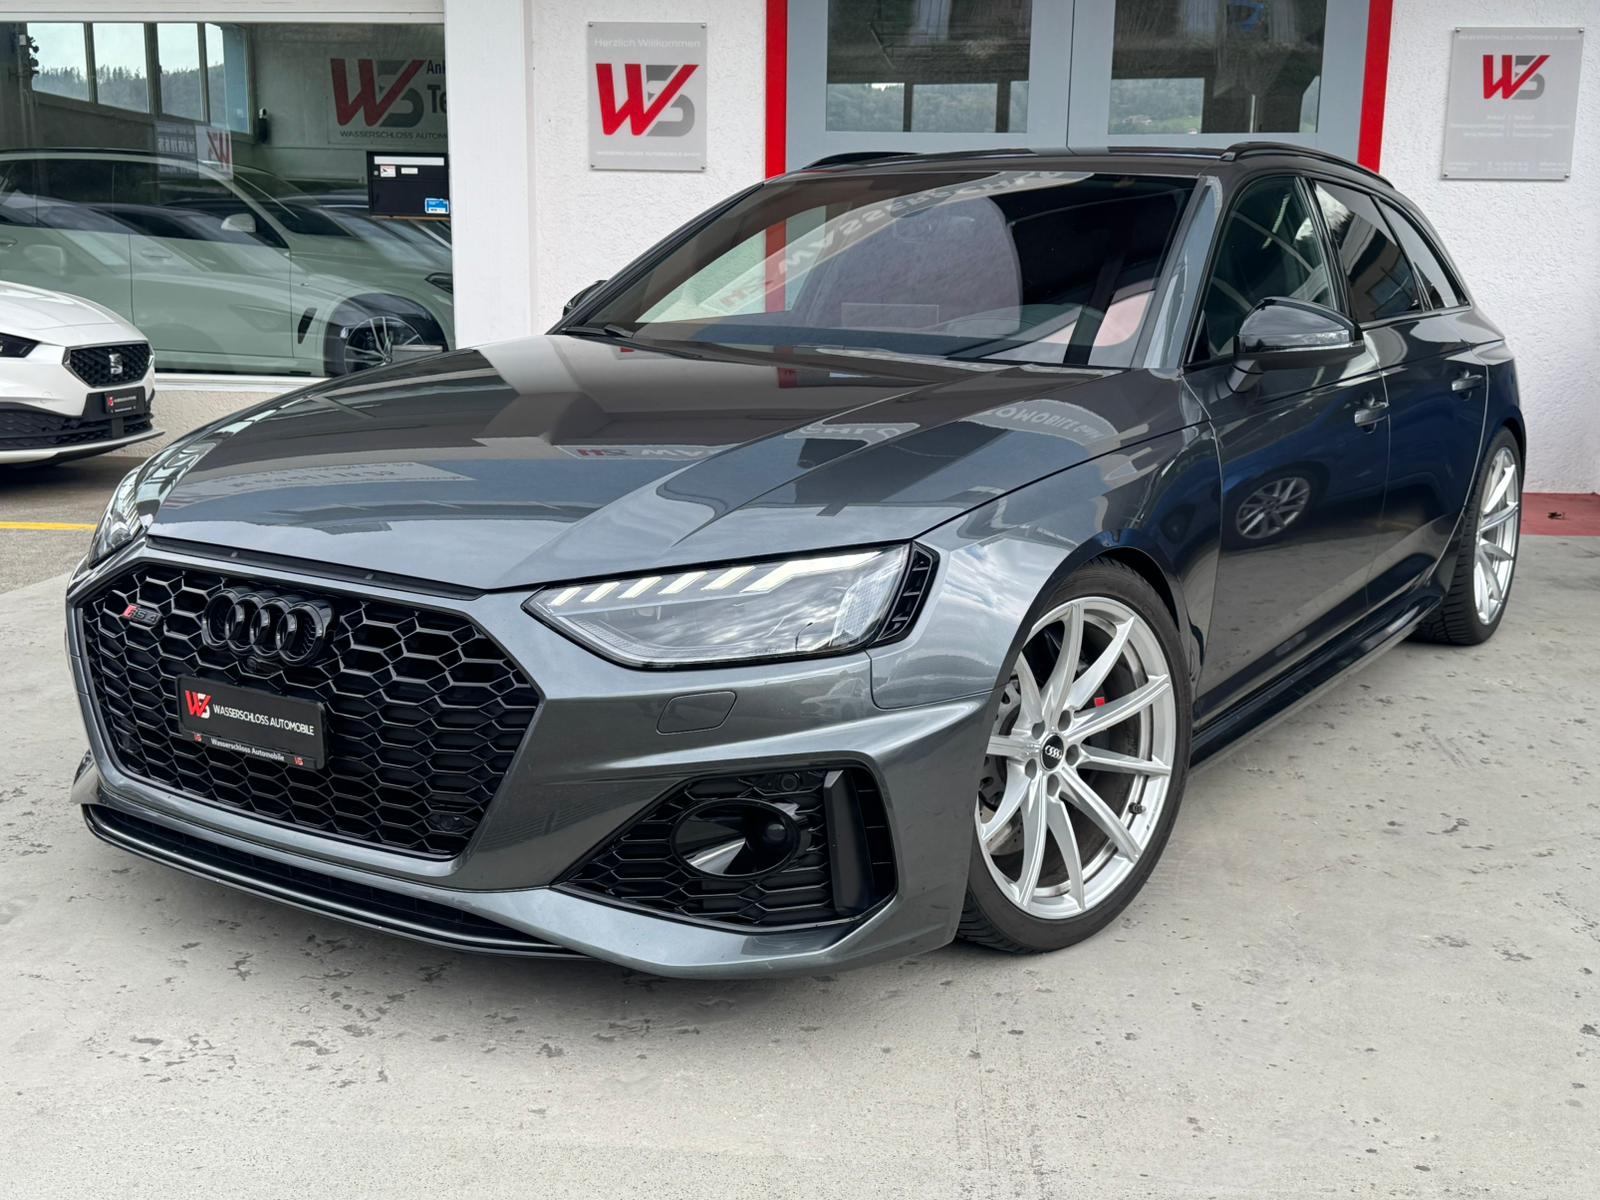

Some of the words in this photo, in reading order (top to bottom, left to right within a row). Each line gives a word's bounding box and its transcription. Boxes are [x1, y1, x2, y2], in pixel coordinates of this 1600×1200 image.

[594, 38, 636, 48] Herzlich
[638, 38, 701, 48] Willkommen
[340, 130, 414, 140] WASSERSCHLOSS
[213, 704, 269, 726] WASSERSCHLOSS
[269, 717, 315, 736] AUTOMOBILE
[210, 737, 251, 754] Wasserschloss
[251, 747, 285, 761] Automobile
